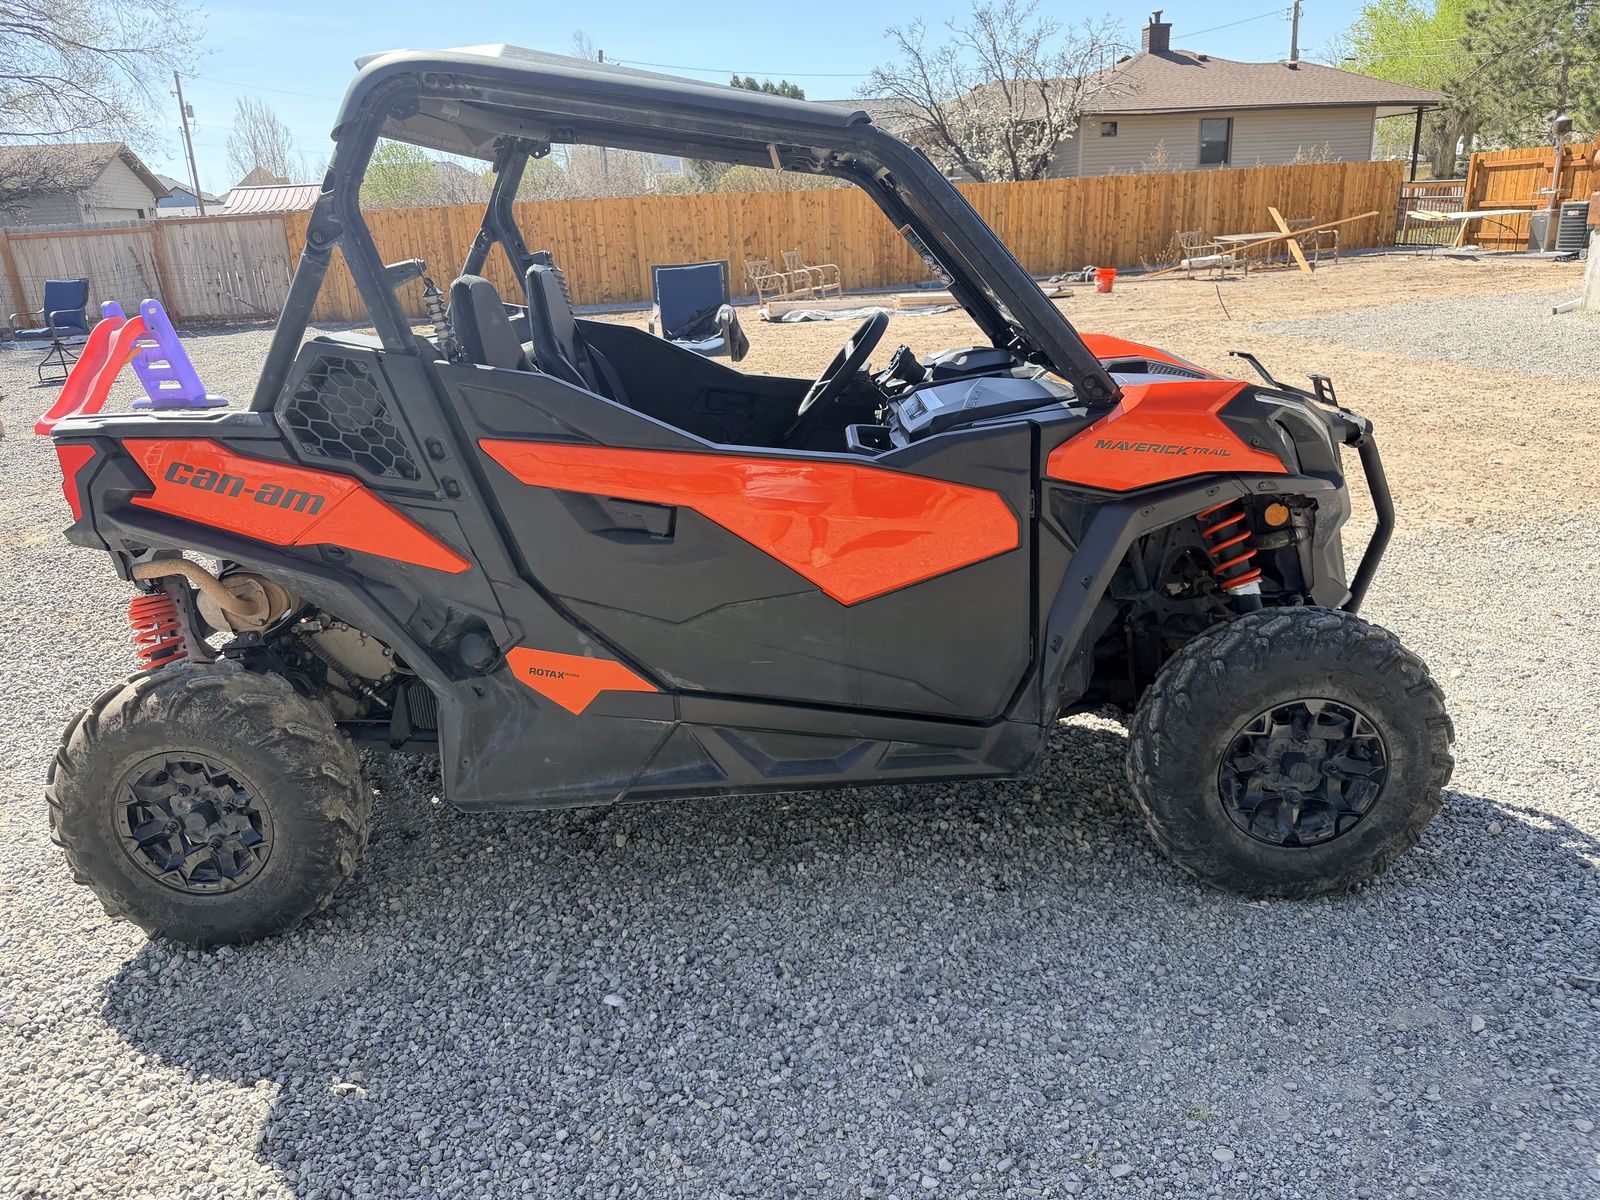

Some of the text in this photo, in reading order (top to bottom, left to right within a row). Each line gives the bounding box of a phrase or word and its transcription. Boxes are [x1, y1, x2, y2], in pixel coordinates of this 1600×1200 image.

[1094, 439, 1231, 457] MAVERICK TRAIL
[164, 461, 326, 516] can-am
[528, 667, 565, 679] ROTAX
